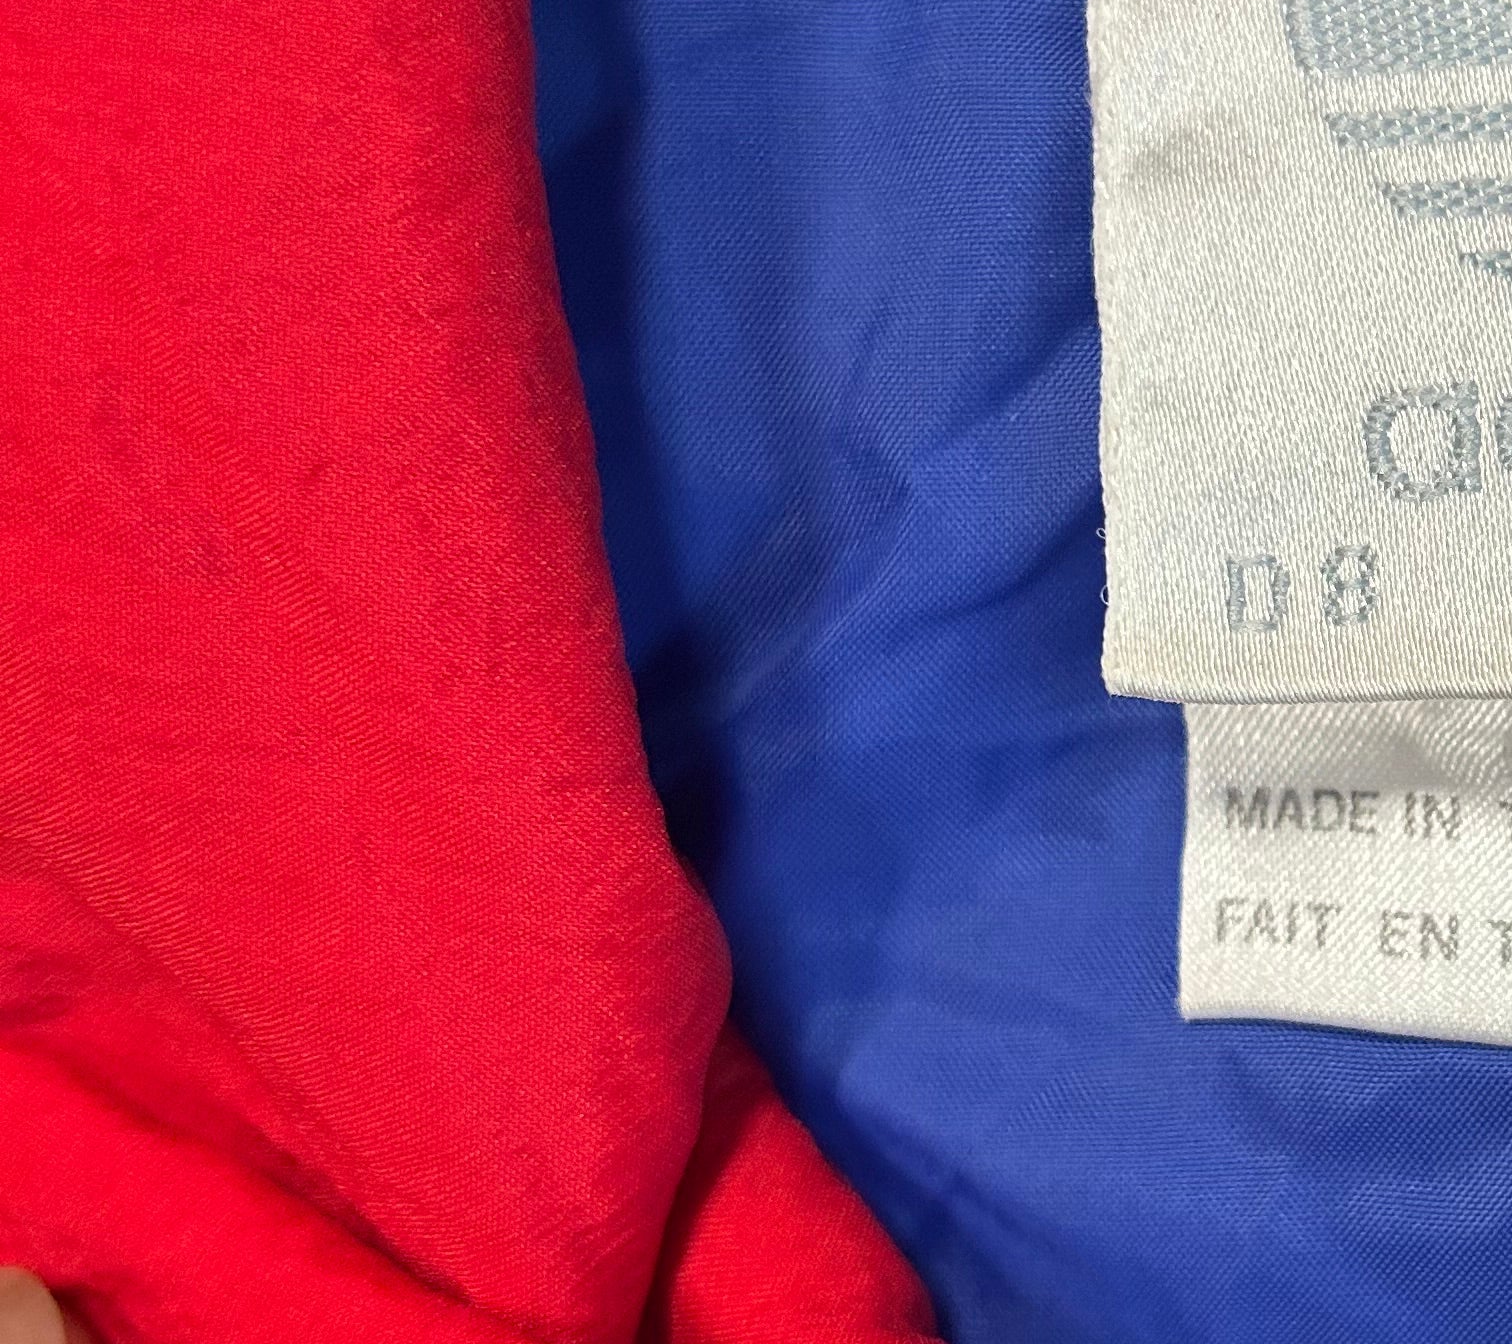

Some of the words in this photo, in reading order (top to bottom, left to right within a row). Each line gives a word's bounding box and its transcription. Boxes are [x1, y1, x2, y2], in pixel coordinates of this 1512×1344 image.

[1320, 543, 1380, 627] 8
[1224, 787, 1380, 836] MADE
[1404, 790, 1461, 841] IN
[1215, 896, 1342, 949] FAIT
[1379, 907, 1459, 961] EN
